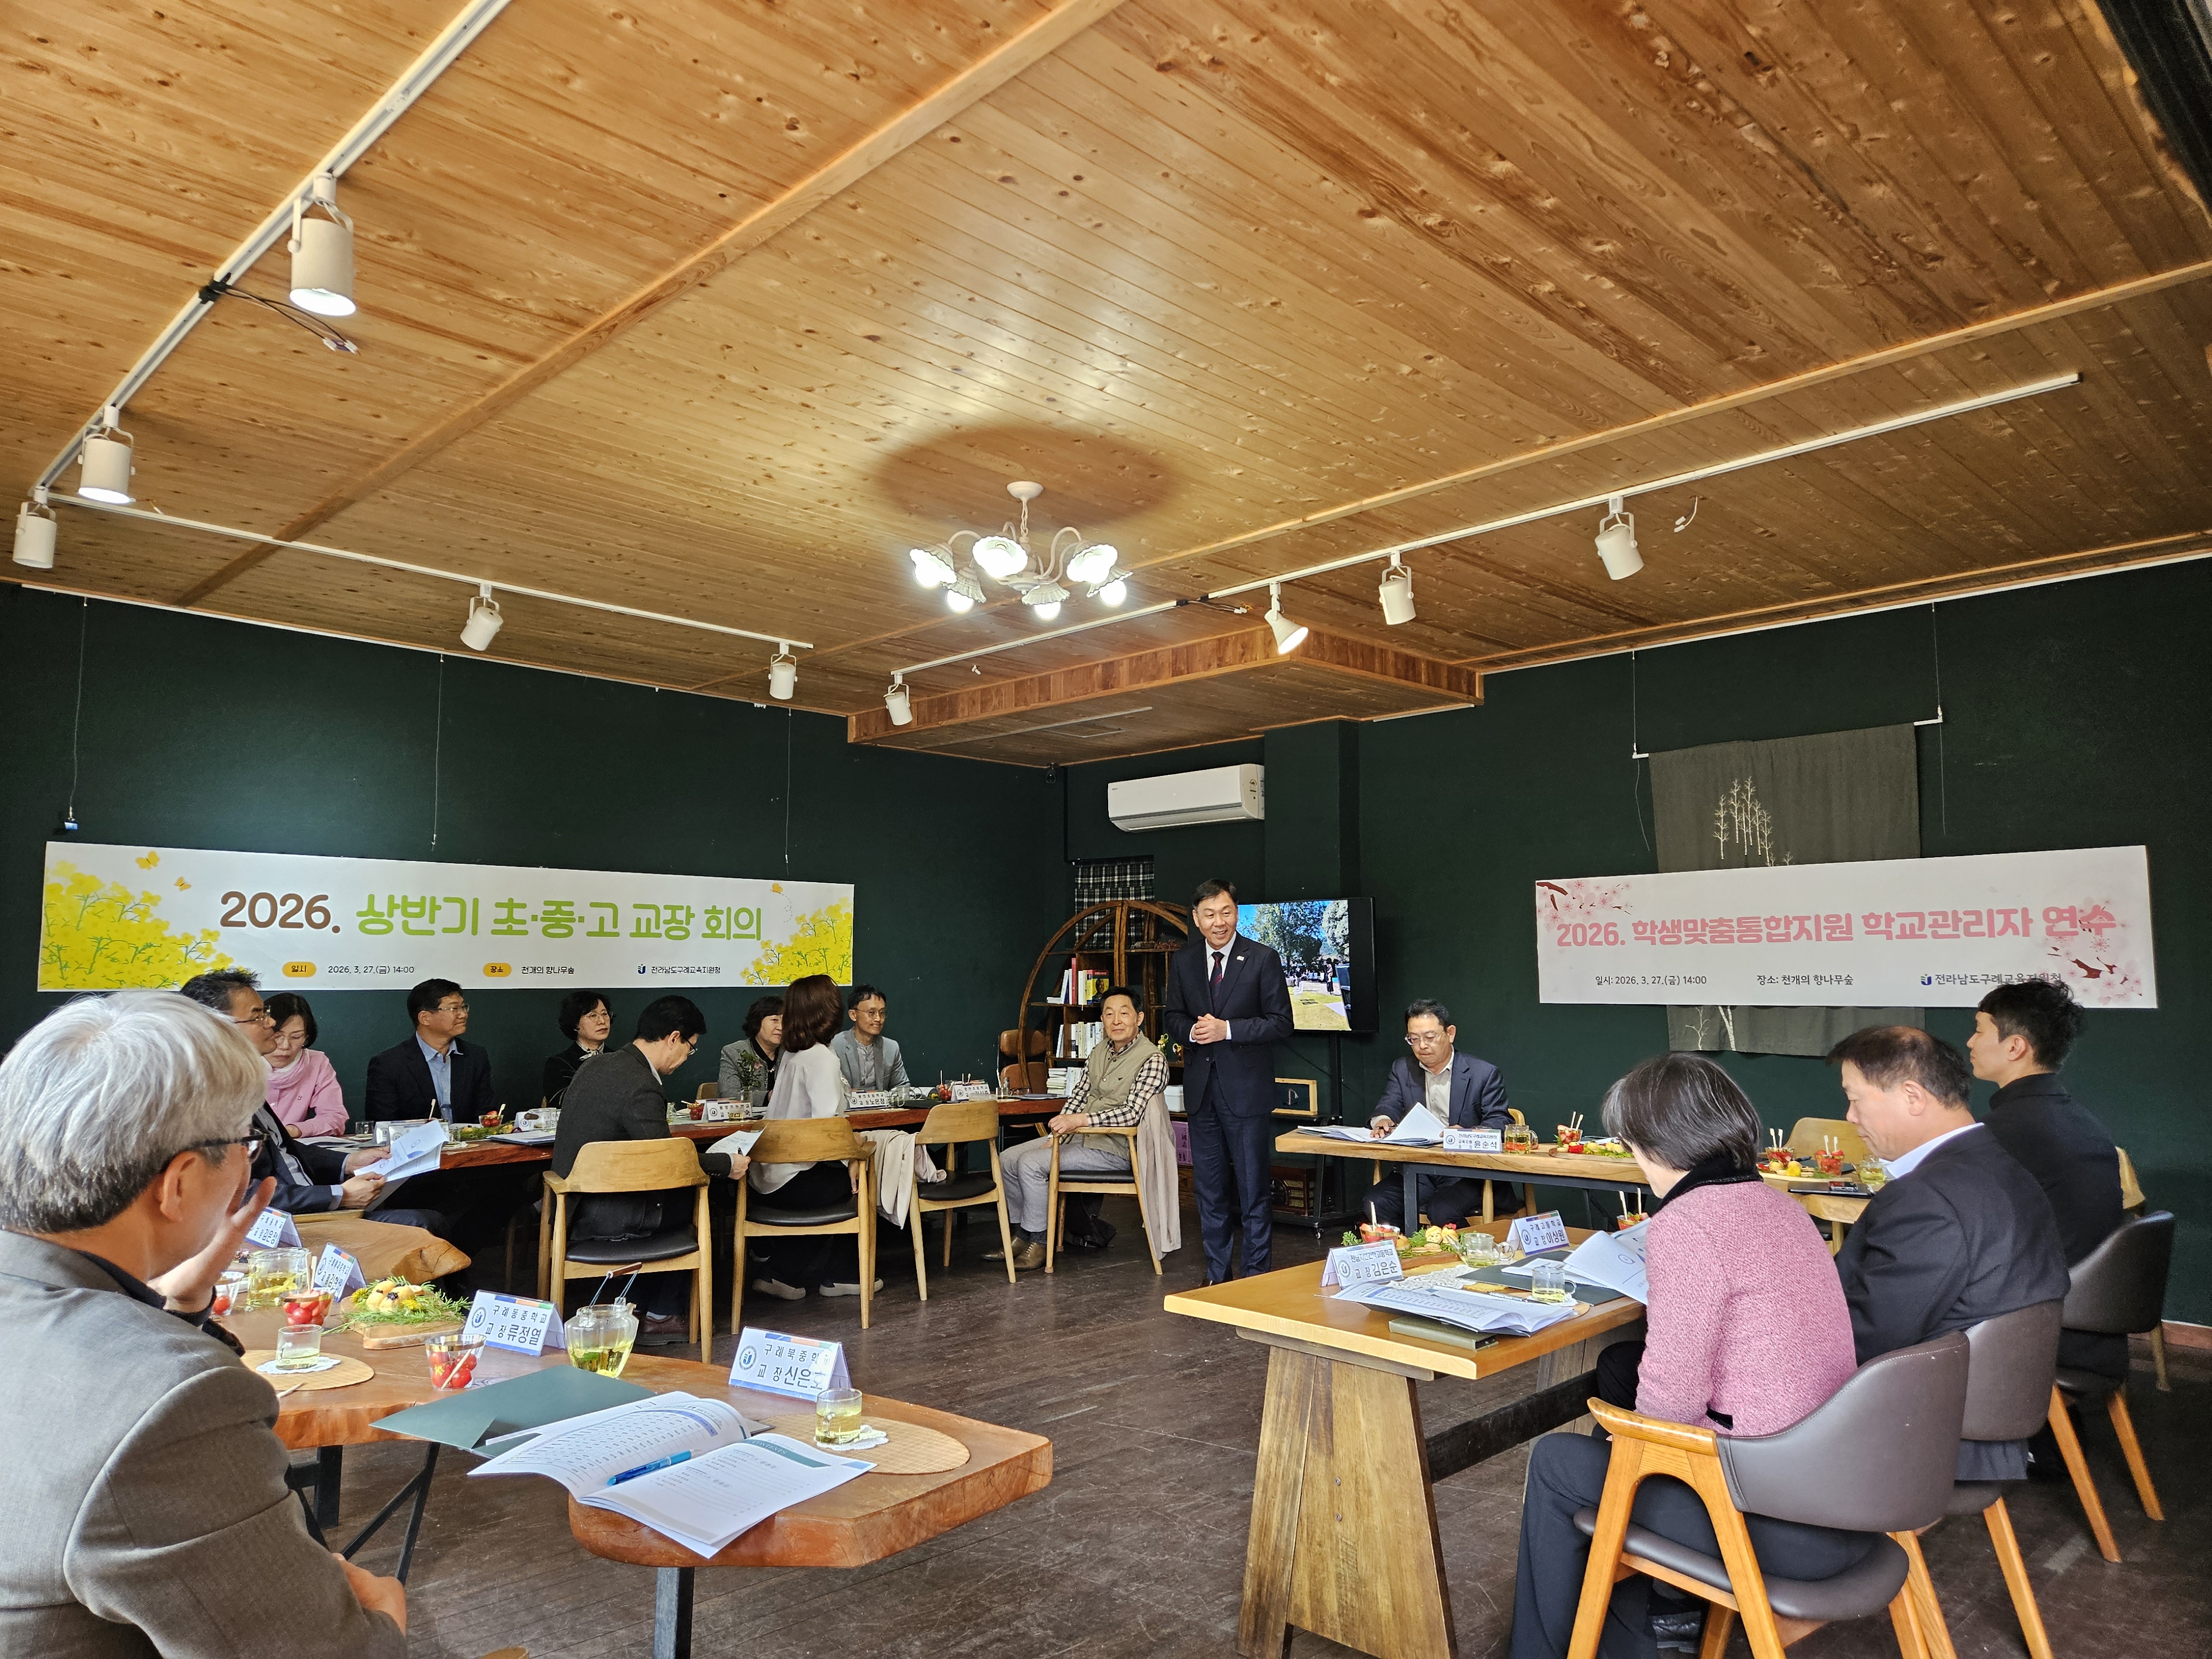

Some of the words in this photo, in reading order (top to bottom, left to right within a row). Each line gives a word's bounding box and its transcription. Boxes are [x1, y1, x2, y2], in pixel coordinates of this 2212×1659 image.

[220, 891, 341, 933] 2026.
[356, 894, 479, 936] 상반기
[491, 898, 620, 938] 초·중·고
[629, 904, 695, 941] 교장
[701, 905, 761, 941] 회의
[1556, 922, 1626, 947] 2026.
[1632, 912, 1854, 946] 학생맞춤통합지원
[1861, 907, 2033, 941] 학교관리자
[2042, 904, 2116, 937] 연수
[291, 964, 307, 973] 일시
[328, 966, 352, 974] 2026.
[353, 966, 361, 974] 3.
[363, 964, 390, 975] 27.(금)
[392, 966, 415, 974] 14:00
[490, 965, 504, 973] 장소
[521, 966, 544, 974] 천개의
[546, 966, 575, 975] 향나무숲
[651, 966, 721, 975] 전라남도구례교육지원청
[1595, 975, 1614, 986] 일시:
[1615, 975, 1639, 986] 2026.
[1641, 975, 1649, 986] 3.
[1651, 975, 1681, 987] 27.(금)
[1683, 975, 1707, 985] 14:00
[1756, 974, 1779, 985] 장소:
[1781, 974, 1811, 985] 천개의
[1813, 974, 1854, 985] 향나무숲
[1474, 1140, 1498, 1149] 윤순석
[1529, 1219, 1562, 1232] 구례고등학교
[262, 1229, 279, 1244] 김은정
[1546, 1229, 1566, 1244] 이상원
[1350, 1249, 1394, 1262] 전남자연과학고등학교
[1371, 1260, 1399, 1277] 김은순
[493, 1305, 547, 1324] 구례동중학교
[507, 1324, 542, 1345] 류정열
[784, 1366, 826, 1390] 신은호
[752, 1439, 787, 1454] CONTENTS
